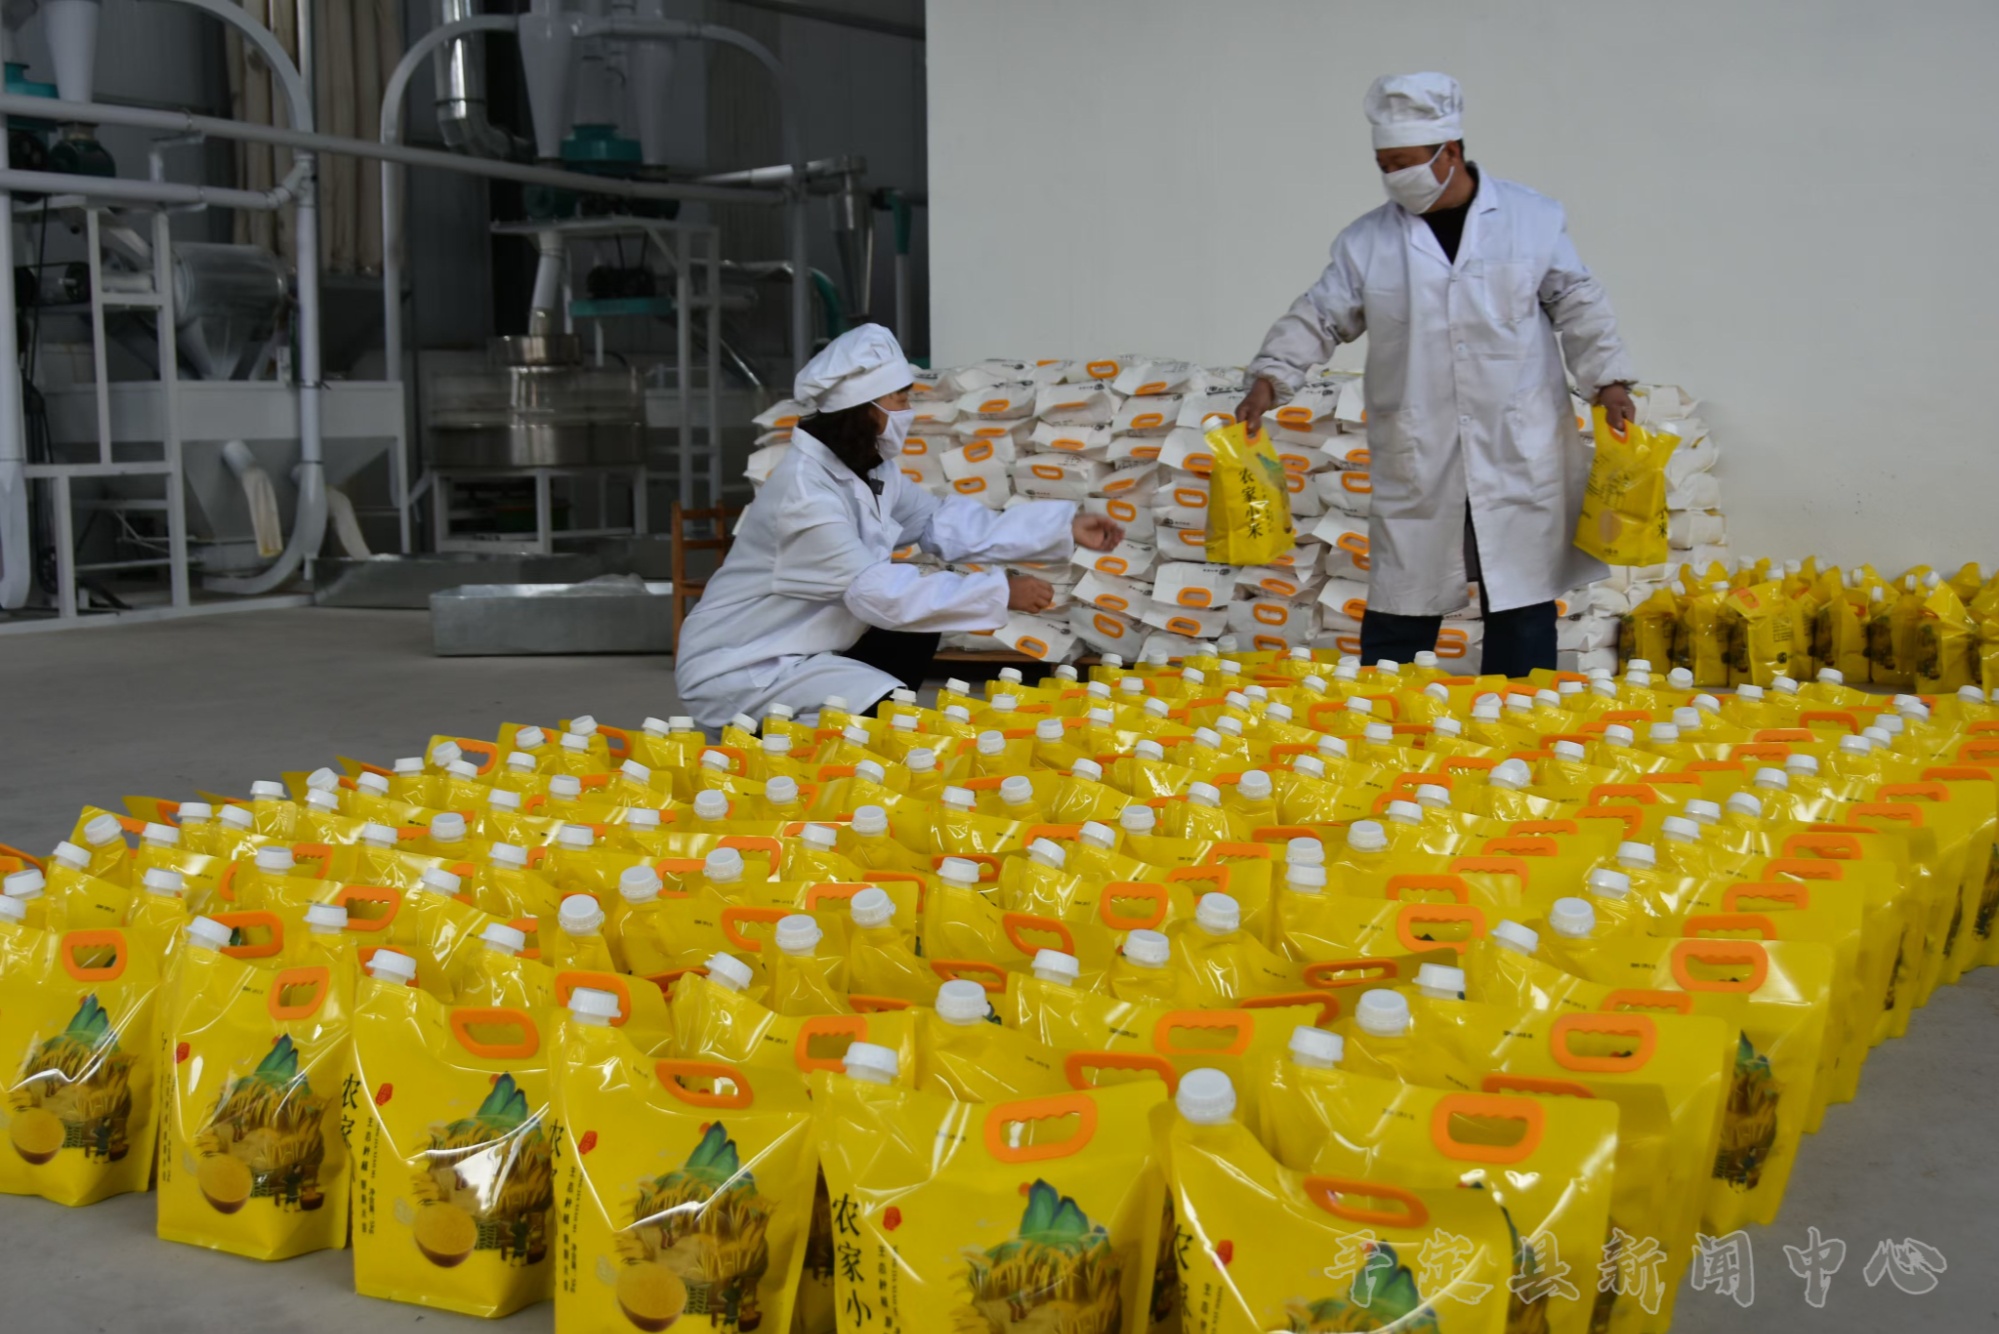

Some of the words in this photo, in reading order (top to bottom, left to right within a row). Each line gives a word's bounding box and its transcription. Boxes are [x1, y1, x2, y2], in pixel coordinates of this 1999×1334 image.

[1239, 468, 1264, 540] 农家小米
[832, 1193, 872, 1328] 农家小
